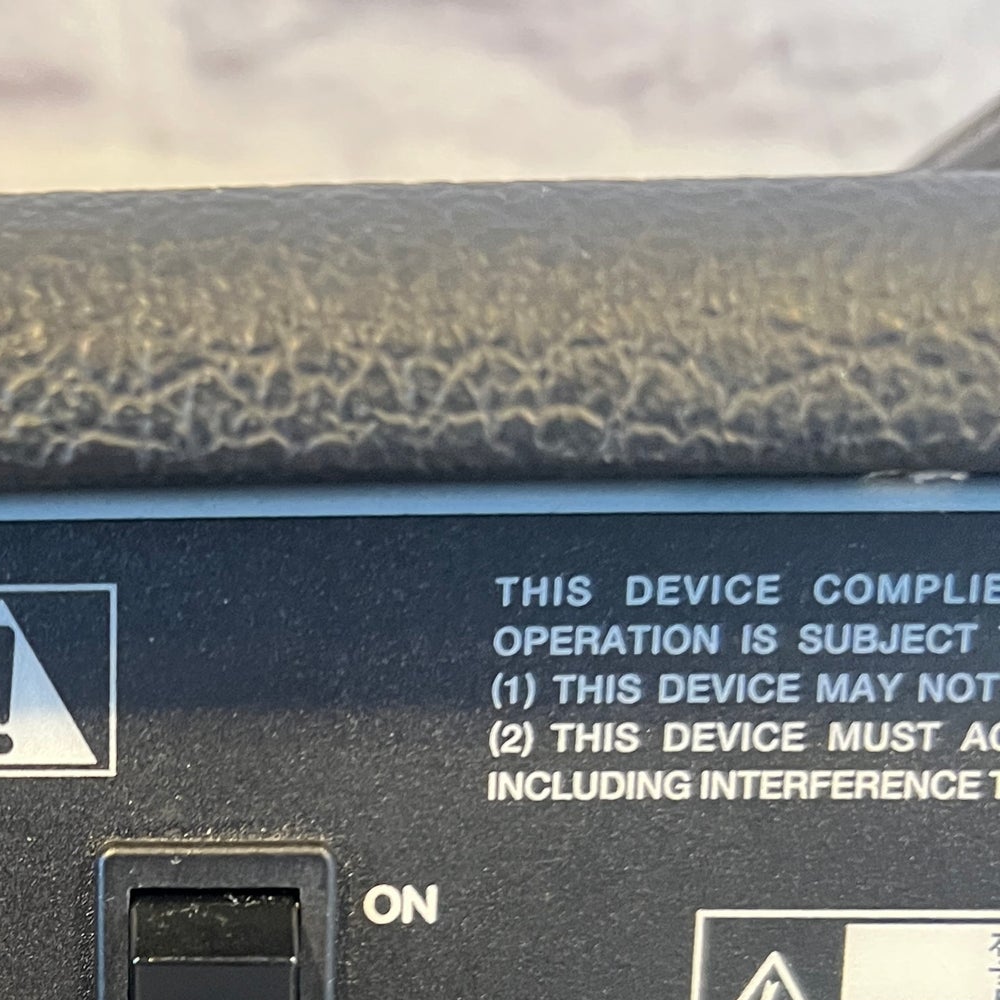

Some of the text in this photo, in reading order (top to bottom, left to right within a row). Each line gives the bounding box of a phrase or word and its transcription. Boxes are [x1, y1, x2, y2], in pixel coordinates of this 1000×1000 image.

[495, 576, 592, 606] THIS
[626, 575, 781, 606] DEVICE
[493, 623, 978, 656] OPERATION IS SUBJECT
[491, 673, 1000, 709] (1) THIS DEVICE MAY NOT
[489, 721, 534, 758] (2)
[550, 723, 640, 753] THIS
[663, 723, 805, 753] DEVICE
[828, 721, 942, 753] MUST
[487, 770, 690, 801] INCLUDING
[700, 769, 982, 800] INTERFERENCE
[363, 884, 438, 924] ON
